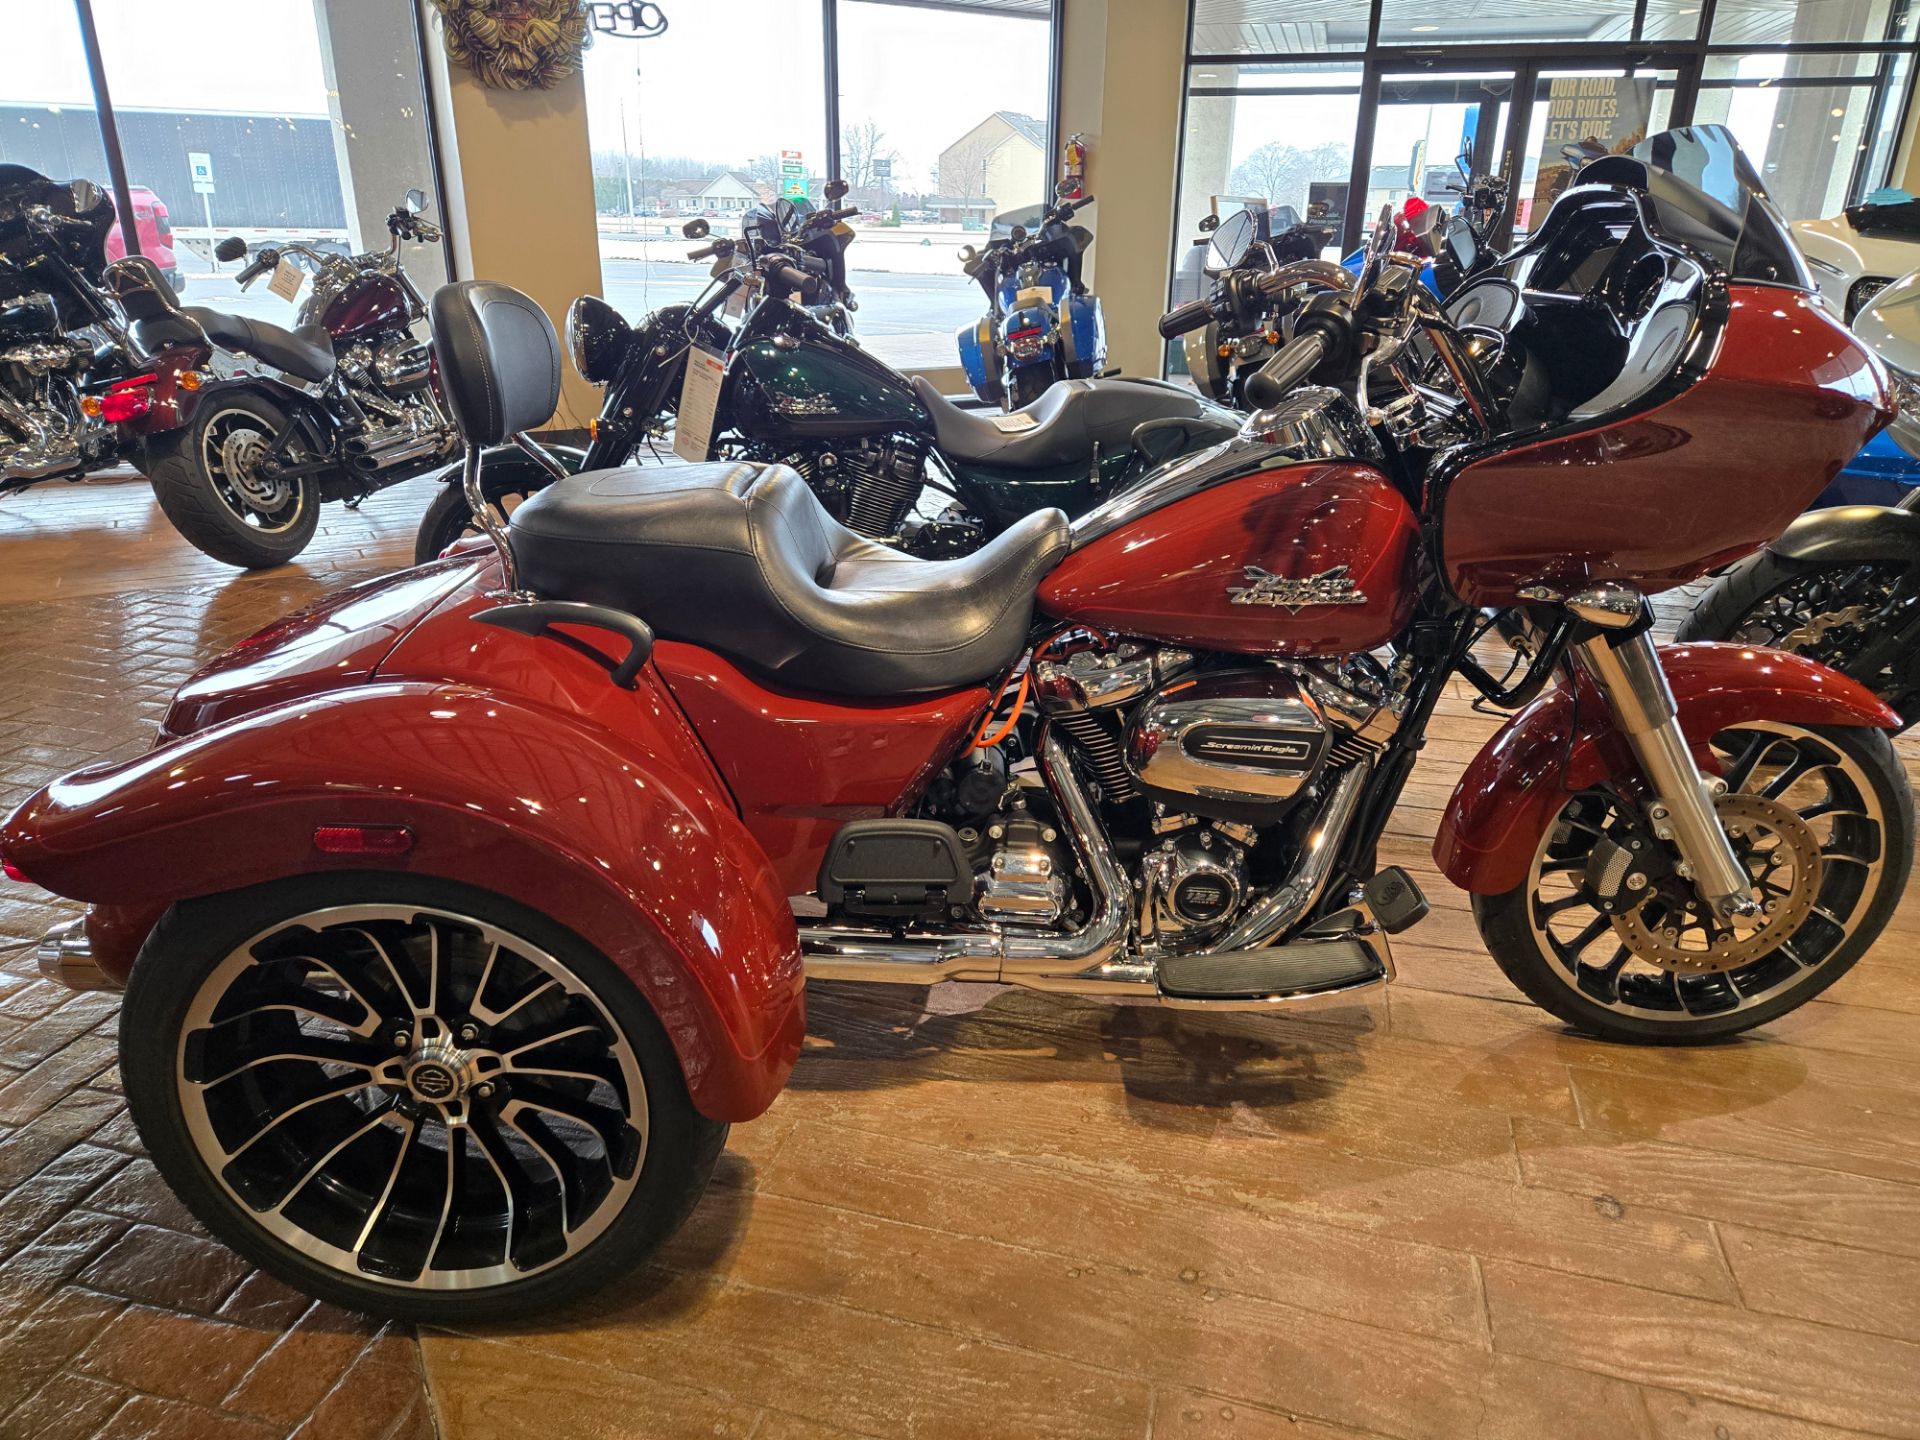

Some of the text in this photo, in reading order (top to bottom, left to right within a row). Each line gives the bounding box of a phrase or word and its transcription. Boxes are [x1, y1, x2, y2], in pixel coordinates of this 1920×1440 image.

[1550, 77, 1617, 97] OUR ROAD.
[1576, 98, 1619, 118] RULES.
[1579, 120, 1612, 140] RIDE.
[1200, 742, 1297, 754] Screamin' Eagle
